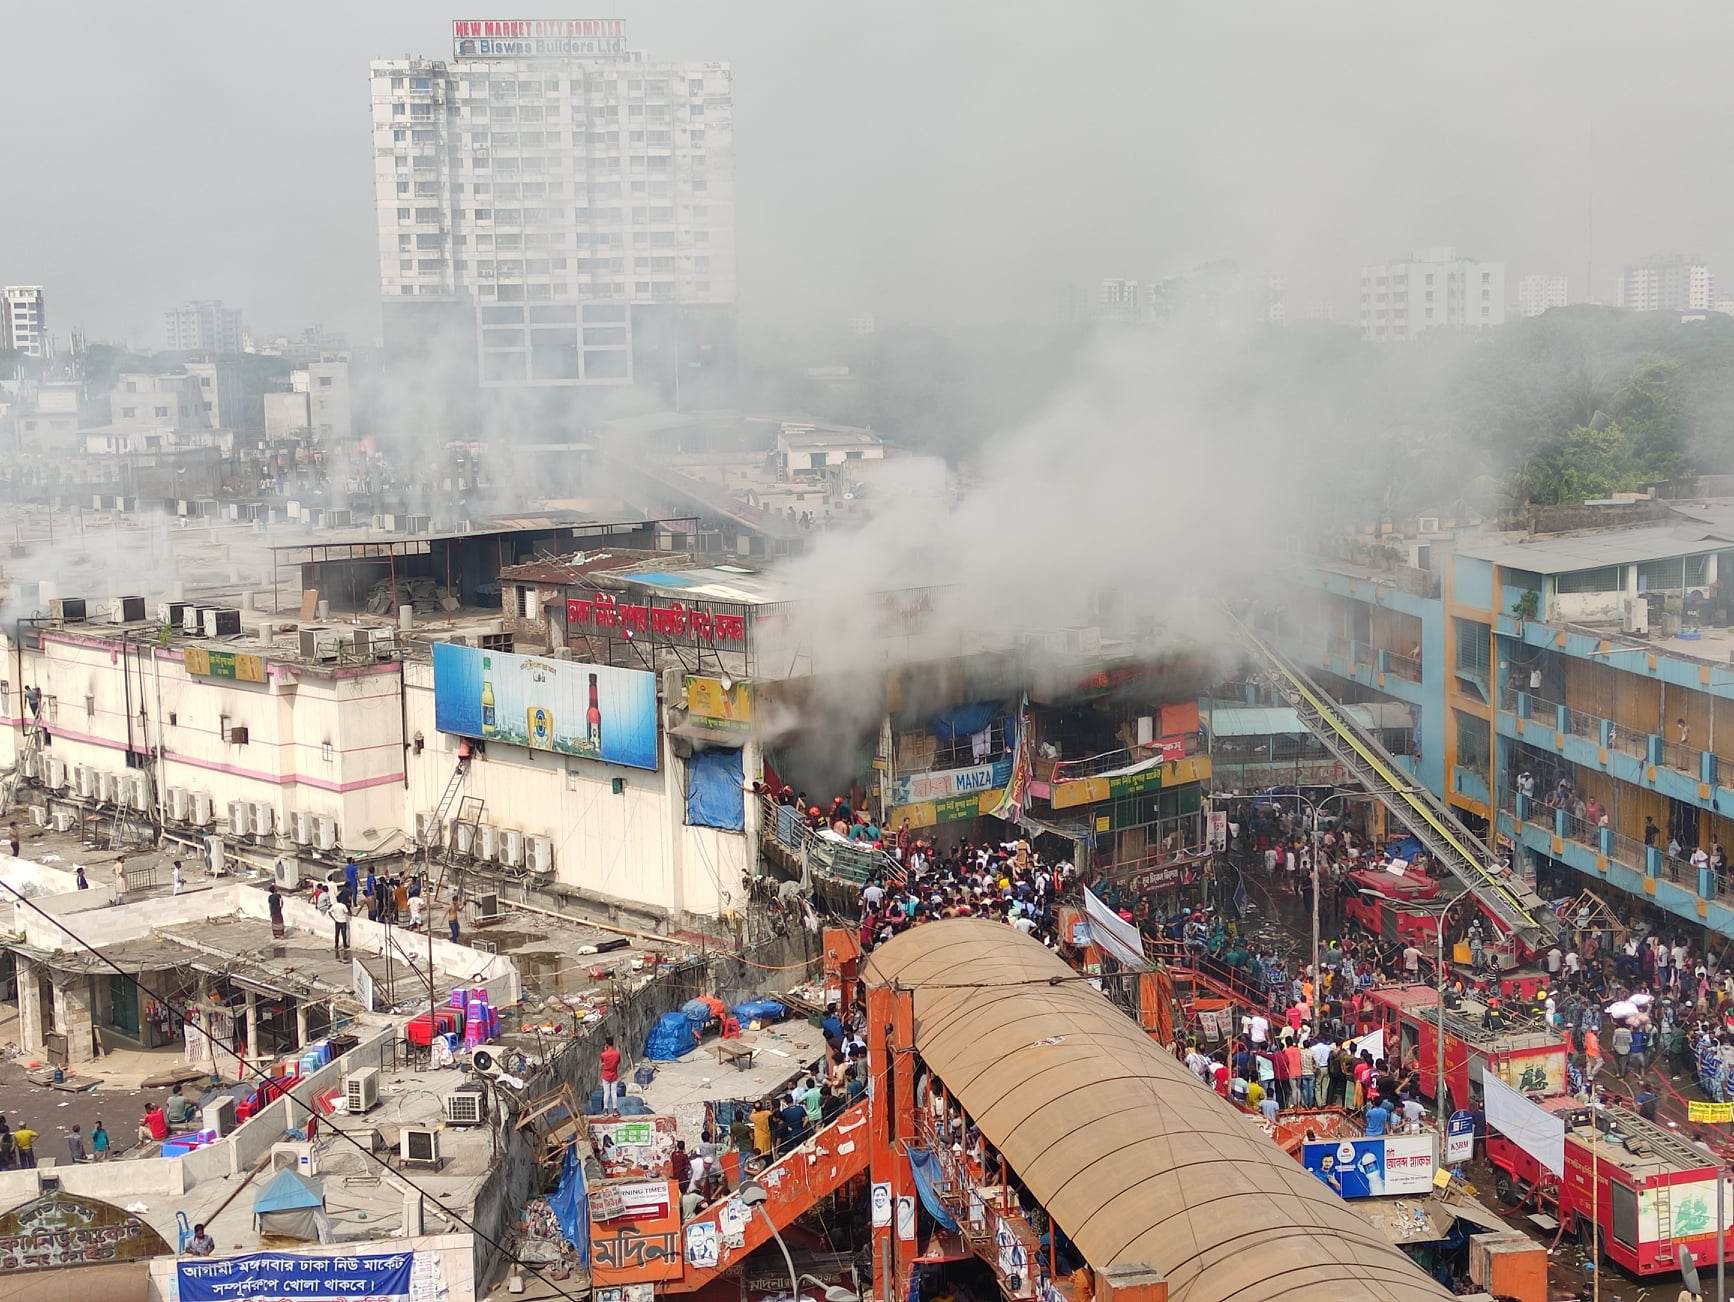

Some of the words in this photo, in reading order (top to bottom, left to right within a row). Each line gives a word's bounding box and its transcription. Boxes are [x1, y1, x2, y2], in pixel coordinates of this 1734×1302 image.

[455, 21, 482, 37] NEW
[485, 21, 532, 37] MARKET
[480, 39, 532, 54] Biswas
[535, 39, 594, 54] Builders
[956, 771, 991, 790] MANZA
[645, 1186, 666, 1194] TIMES
[592, 1225, 680, 1269] মদিনা
[181, 1262, 233, 1279] আগামী
[300, 1258, 328, 1273] ঢাকা
[334, 1256, 360, 1272] নিউ
[364, 1255, 405, 1272] মার্কেট
[283, 1278, 321, 1292] খোলা
